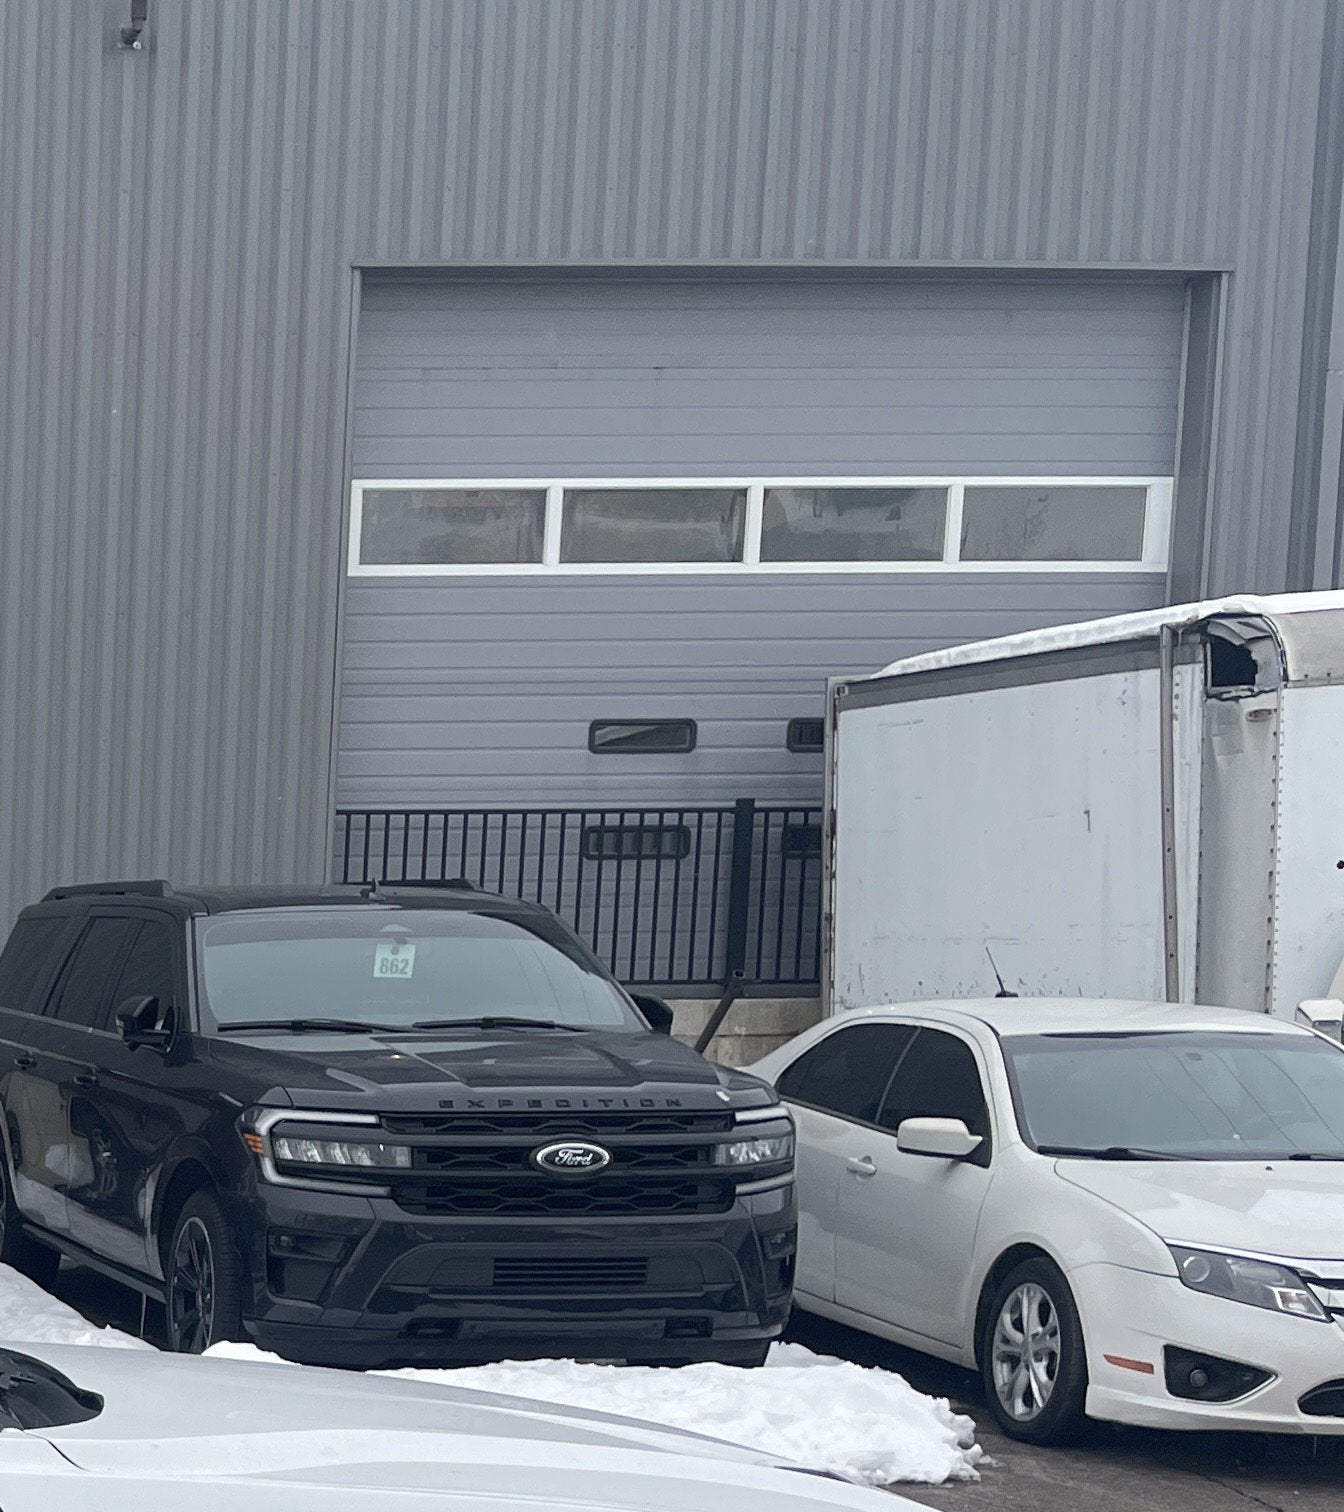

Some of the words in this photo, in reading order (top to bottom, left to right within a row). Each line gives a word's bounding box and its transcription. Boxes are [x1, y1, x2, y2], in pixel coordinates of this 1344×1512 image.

[380, 957, 409, 975] 862
[438, 1097, 683, 1109] EXPEDITION
[555, 1148, 593, 1165] Ford
